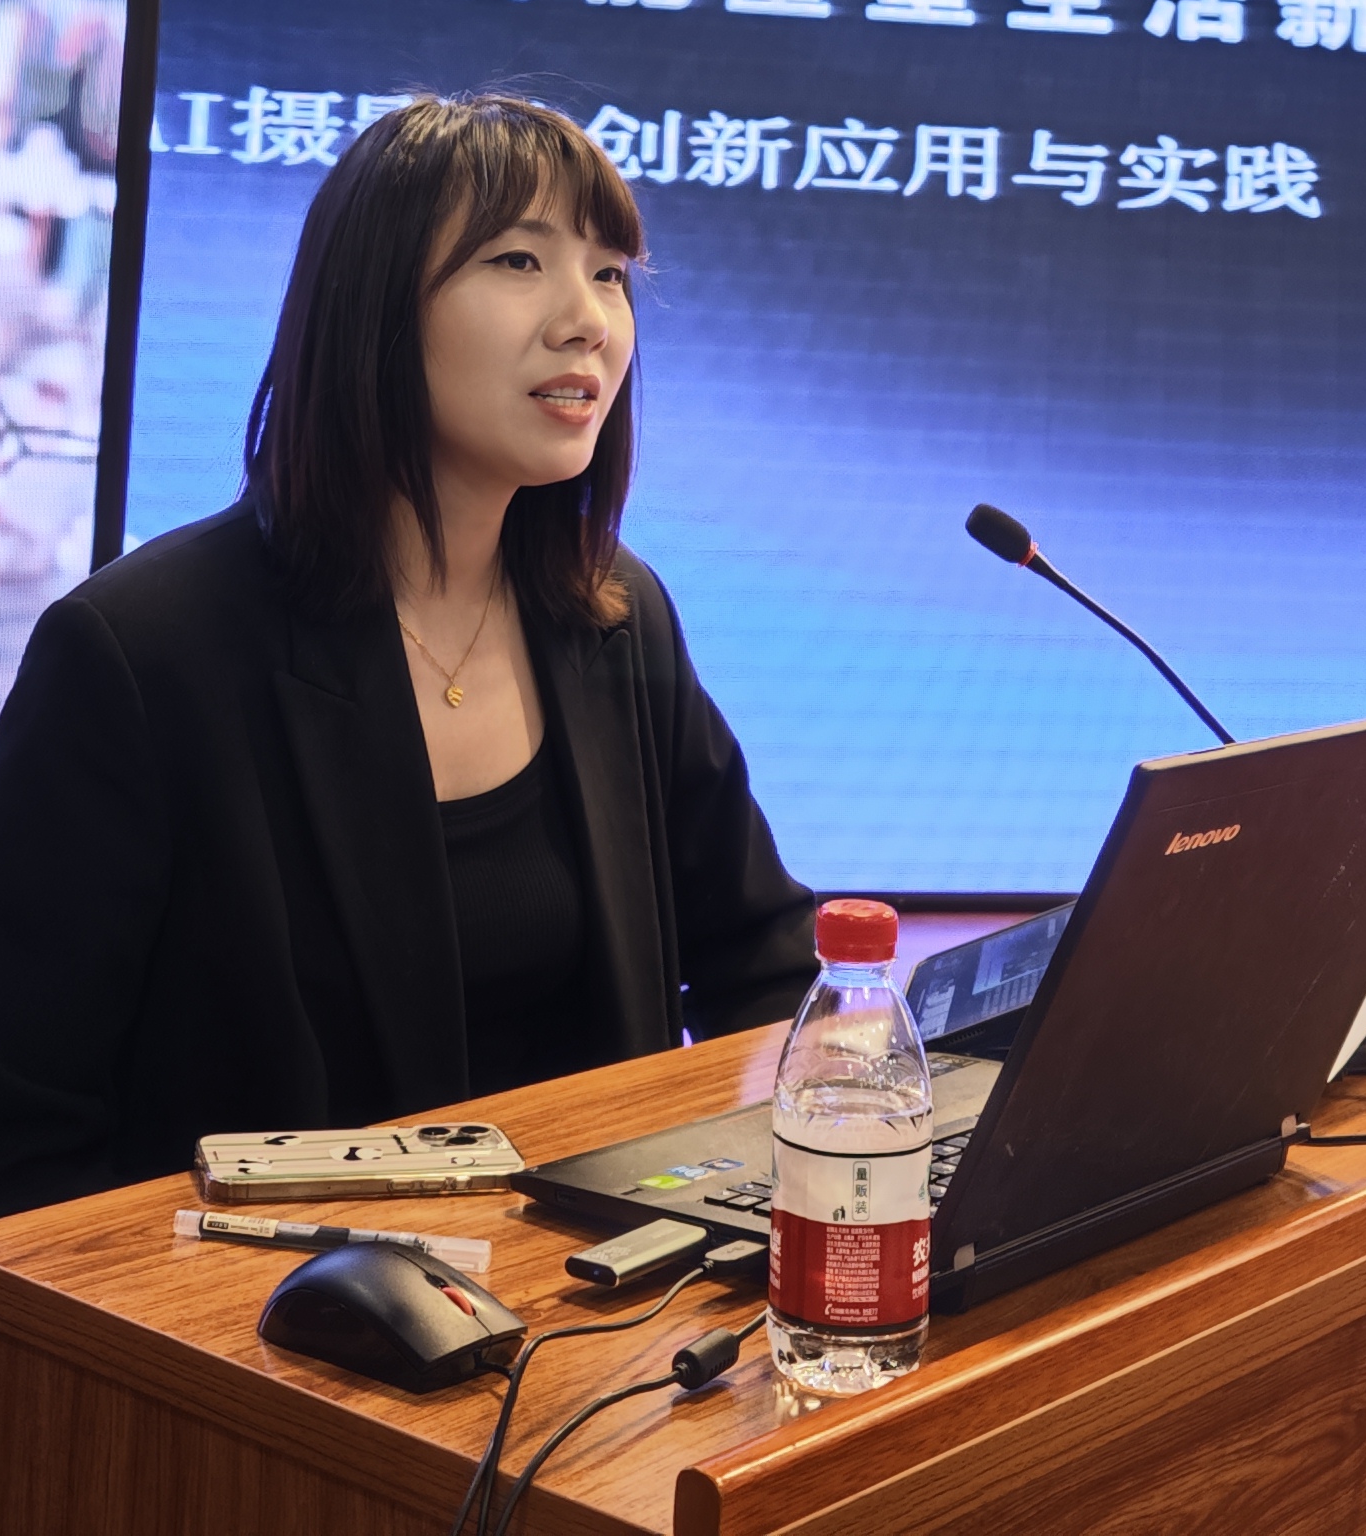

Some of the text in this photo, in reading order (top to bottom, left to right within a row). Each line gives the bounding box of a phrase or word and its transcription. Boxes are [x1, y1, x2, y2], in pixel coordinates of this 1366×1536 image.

[1164, 822, 1241, 857] lenovo
[855, 1167, 868, 1214] 量贩装
